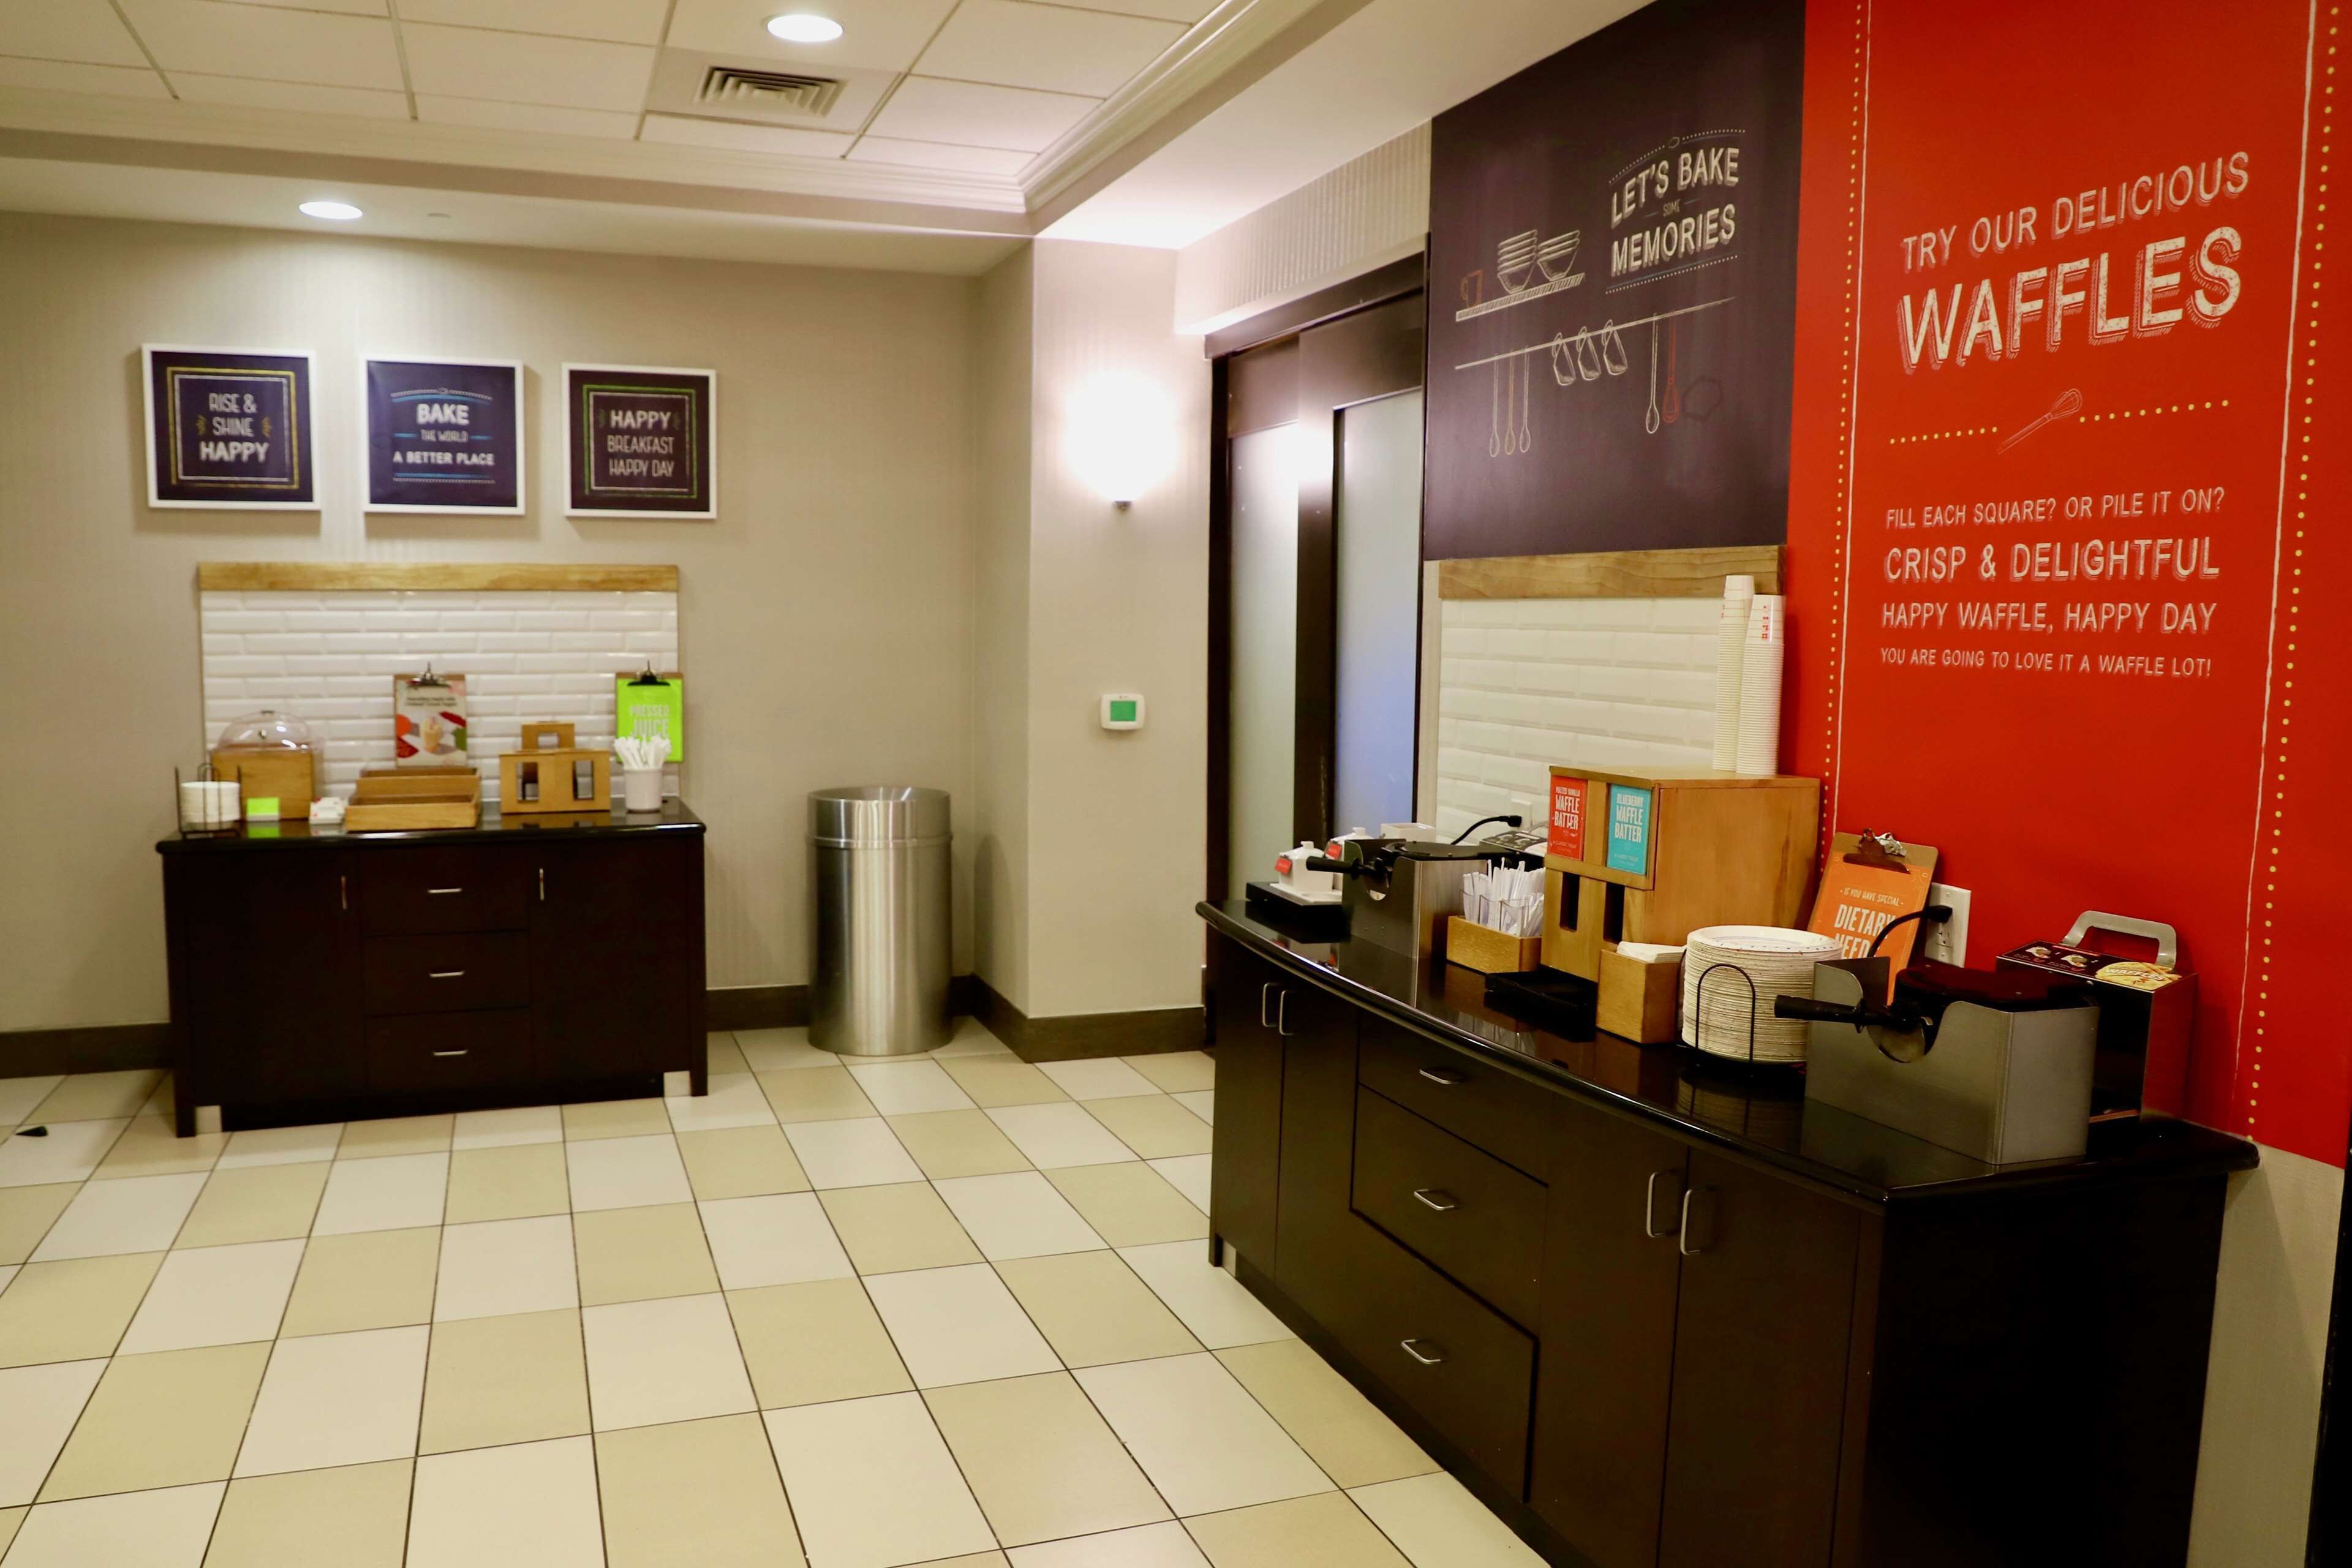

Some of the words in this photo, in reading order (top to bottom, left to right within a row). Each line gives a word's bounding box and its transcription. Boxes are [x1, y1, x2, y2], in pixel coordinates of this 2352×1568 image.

[1611, 160, 1669, 229] LET'S
[1677, 147, 1740, 191] BAKE
[1662, 198, 1681, 216] SOME
[1902, 225, 1957, 273] TRY
[1969, 206, 2037, 258] OUR
[2051, 151, 2250, 240] DELICIOUS
[1611, 203, 1735, 276] MEMORIES
[1898, 226, 2242, 375] WAFFLES
[209, 392, 241, 413] RISE
[243, 393, 257, 413] &
[416, 402, 470, 426] BAKE
[609, 409, 672, 430] HAPPY
[212, 417, 254, 437] SHINE
[420, 429, 436, 442] THE
[438, 430, 469, 443] WORLD
[199, 440, 270, 464] HAPPY
[607, 434, 674, 454] BREAKFAST
[393, 450, 404, 463] A
[406, 450, 453, 464] BETTER
[456, 452, 495, 466] PLACE
[608, 458, 649, 477] HAPPY
[651, 459, 674, 478] DAY
[1887, 508, 1916, 529] FILL
[1923, 504, 1967, 527] EACH
[1973, 498, 2057, 525] SQUARE?
[2065, 496, 2093, 519] OR
[2101, 492, 2144, 518] PILE
[2152, 491, 2172, 515] IT
[2180, 486, 2225, 514] ON?
[1885, 546, 1967, 583] CRISP
[1980, 543, 1997, 581] &
[2010, 536, 2220, 581] DELIGHTFUL
[1882, 602, 1948, 629] HAPPY
[1958, 602, 2053, 634] WAFFLE,
[2064, 602, 2150, 633] HAPPY
[2160, 602, 2217, 634] DAY
[1881, 647, 1906, 666] YOU
[1909, 649, 1937, 666] ARE
[1942, 649, 1985, 668] GOING
[1991, 651, 2010, 669] TO
[2015, 652, 2054, 671] LOVE
[2059, 654, 2074, 673] IT
[2078, 654, 2090, 674] A
[2098, 654, 2165, 677] WAFFLE
[2171, 657, 2212, 679] LOT!
[1555, 794, 1580, 814] WAFFLE
[1554, 810, 1579, 831] BATTER
[1616, 805, 1643, 826] WAFFLE
[1614, 822, 1642, 843] BATTER
[1851, 889, 1861, 899] YOU
[1862, 892, 1876, 902] HAVE
[1877, 894, 1899, 907] SPECIAL
[2105, 968, 2165, 981] WAFFLES
